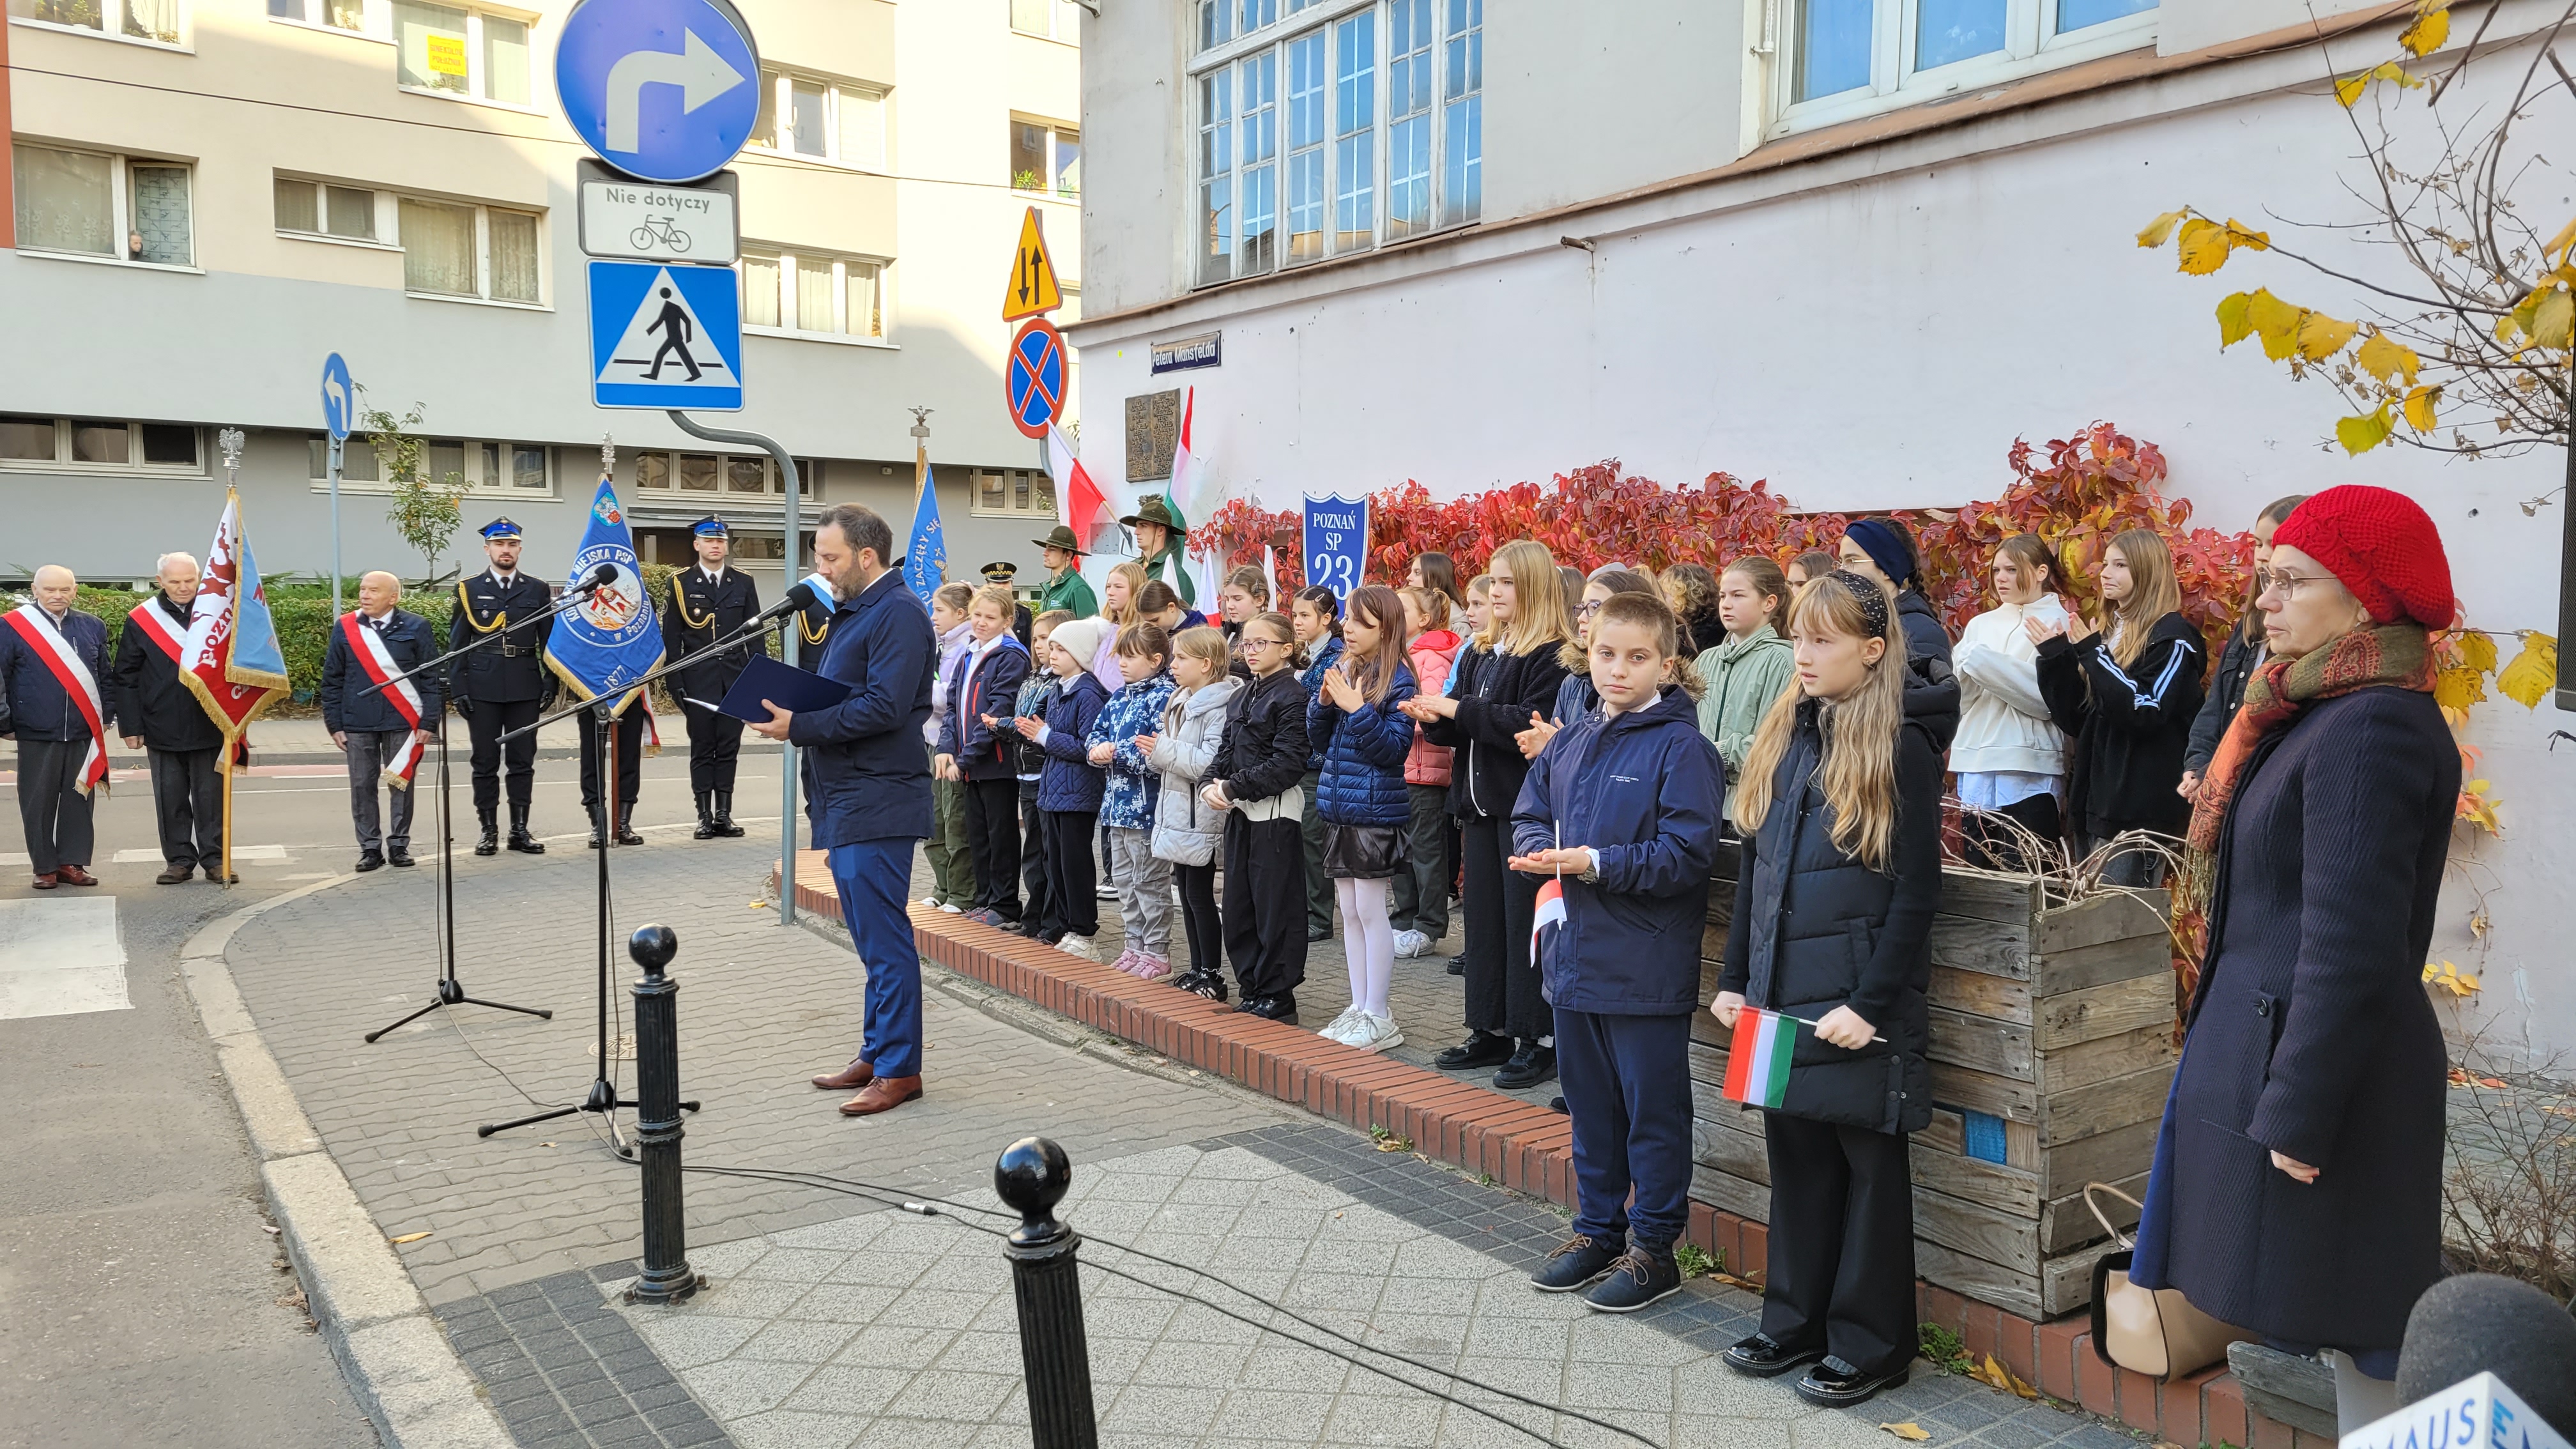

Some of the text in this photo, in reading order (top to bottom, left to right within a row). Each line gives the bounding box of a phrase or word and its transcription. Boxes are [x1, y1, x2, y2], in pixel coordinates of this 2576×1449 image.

[606, 187, 710, 214] Nie dotyczy
[1152, 341, 1216, 367] Petera Mansfelda
[926, 518, 941, 534] SIĘ
[1313, 510, 1356, 530] POZNAŃ
[1326, 532, 1342, 551] SP
[572, 548, 611, 576] MIEJSKA
[615, 549, 633, 564] PSP
[1314, 553, 1353, 601] 23
[625, 600, 650, 637] Poznaniu
[604, 665, 627, 690] 1877
